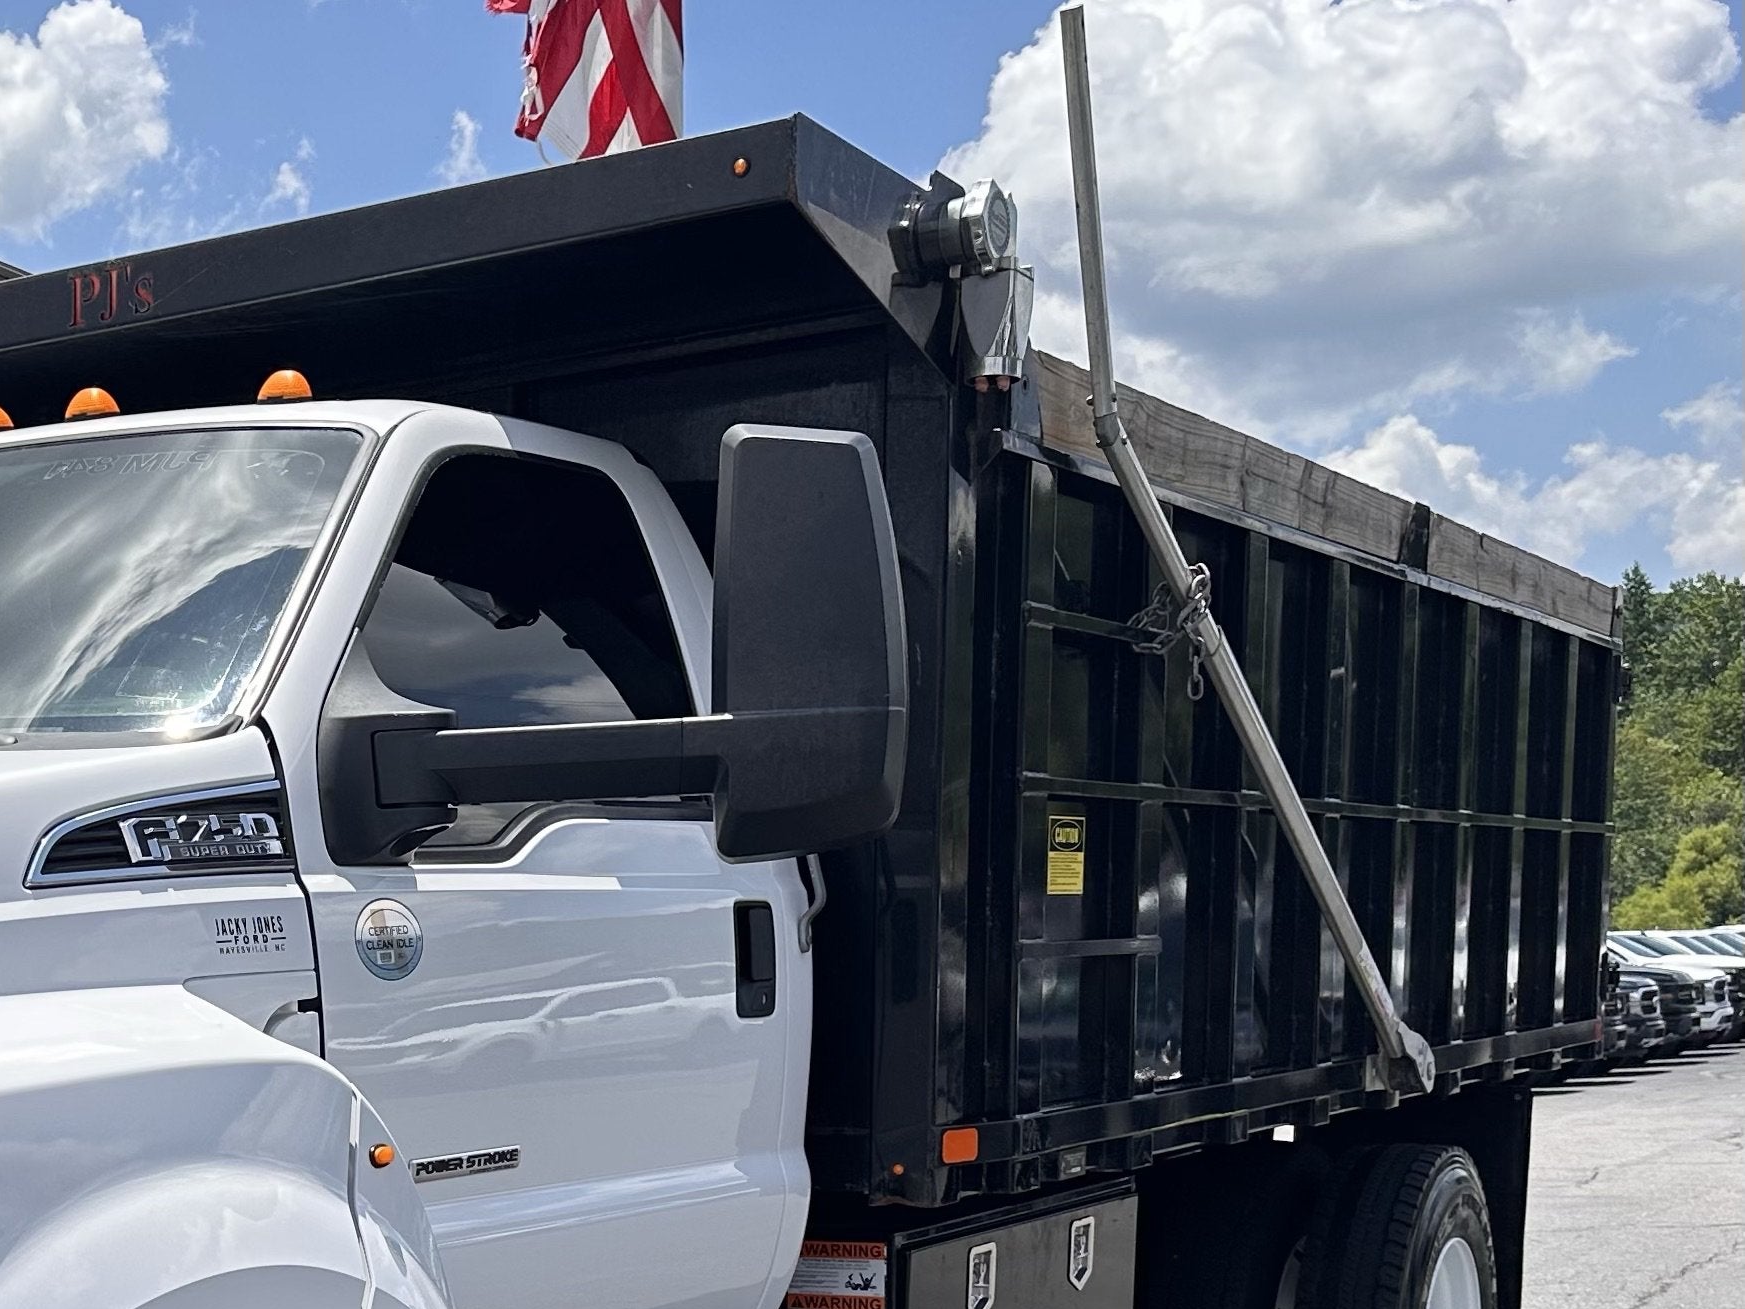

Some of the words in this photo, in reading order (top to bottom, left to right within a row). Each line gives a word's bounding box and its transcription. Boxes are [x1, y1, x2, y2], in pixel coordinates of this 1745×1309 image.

[67, 263, 154, 328] PJ's
[180, 844, 230, 858] SUPER
[236, 842, 271, 856] DUTY
[214, 916, 248, 937] JACKY
[251, 915, 285, 935] JONES
[368, 924, 409, 937] CERTIFIED
[233, 934, 270, 945] FORD
[365, 939, 394, 951] CLEAN
[396, 937, 415, 949] IDLE
[415, 1156, 464, 1177] POWER
[466, 1148, 518, 1168] STROKE
[804, 1243, 882, 1258] WARNING
